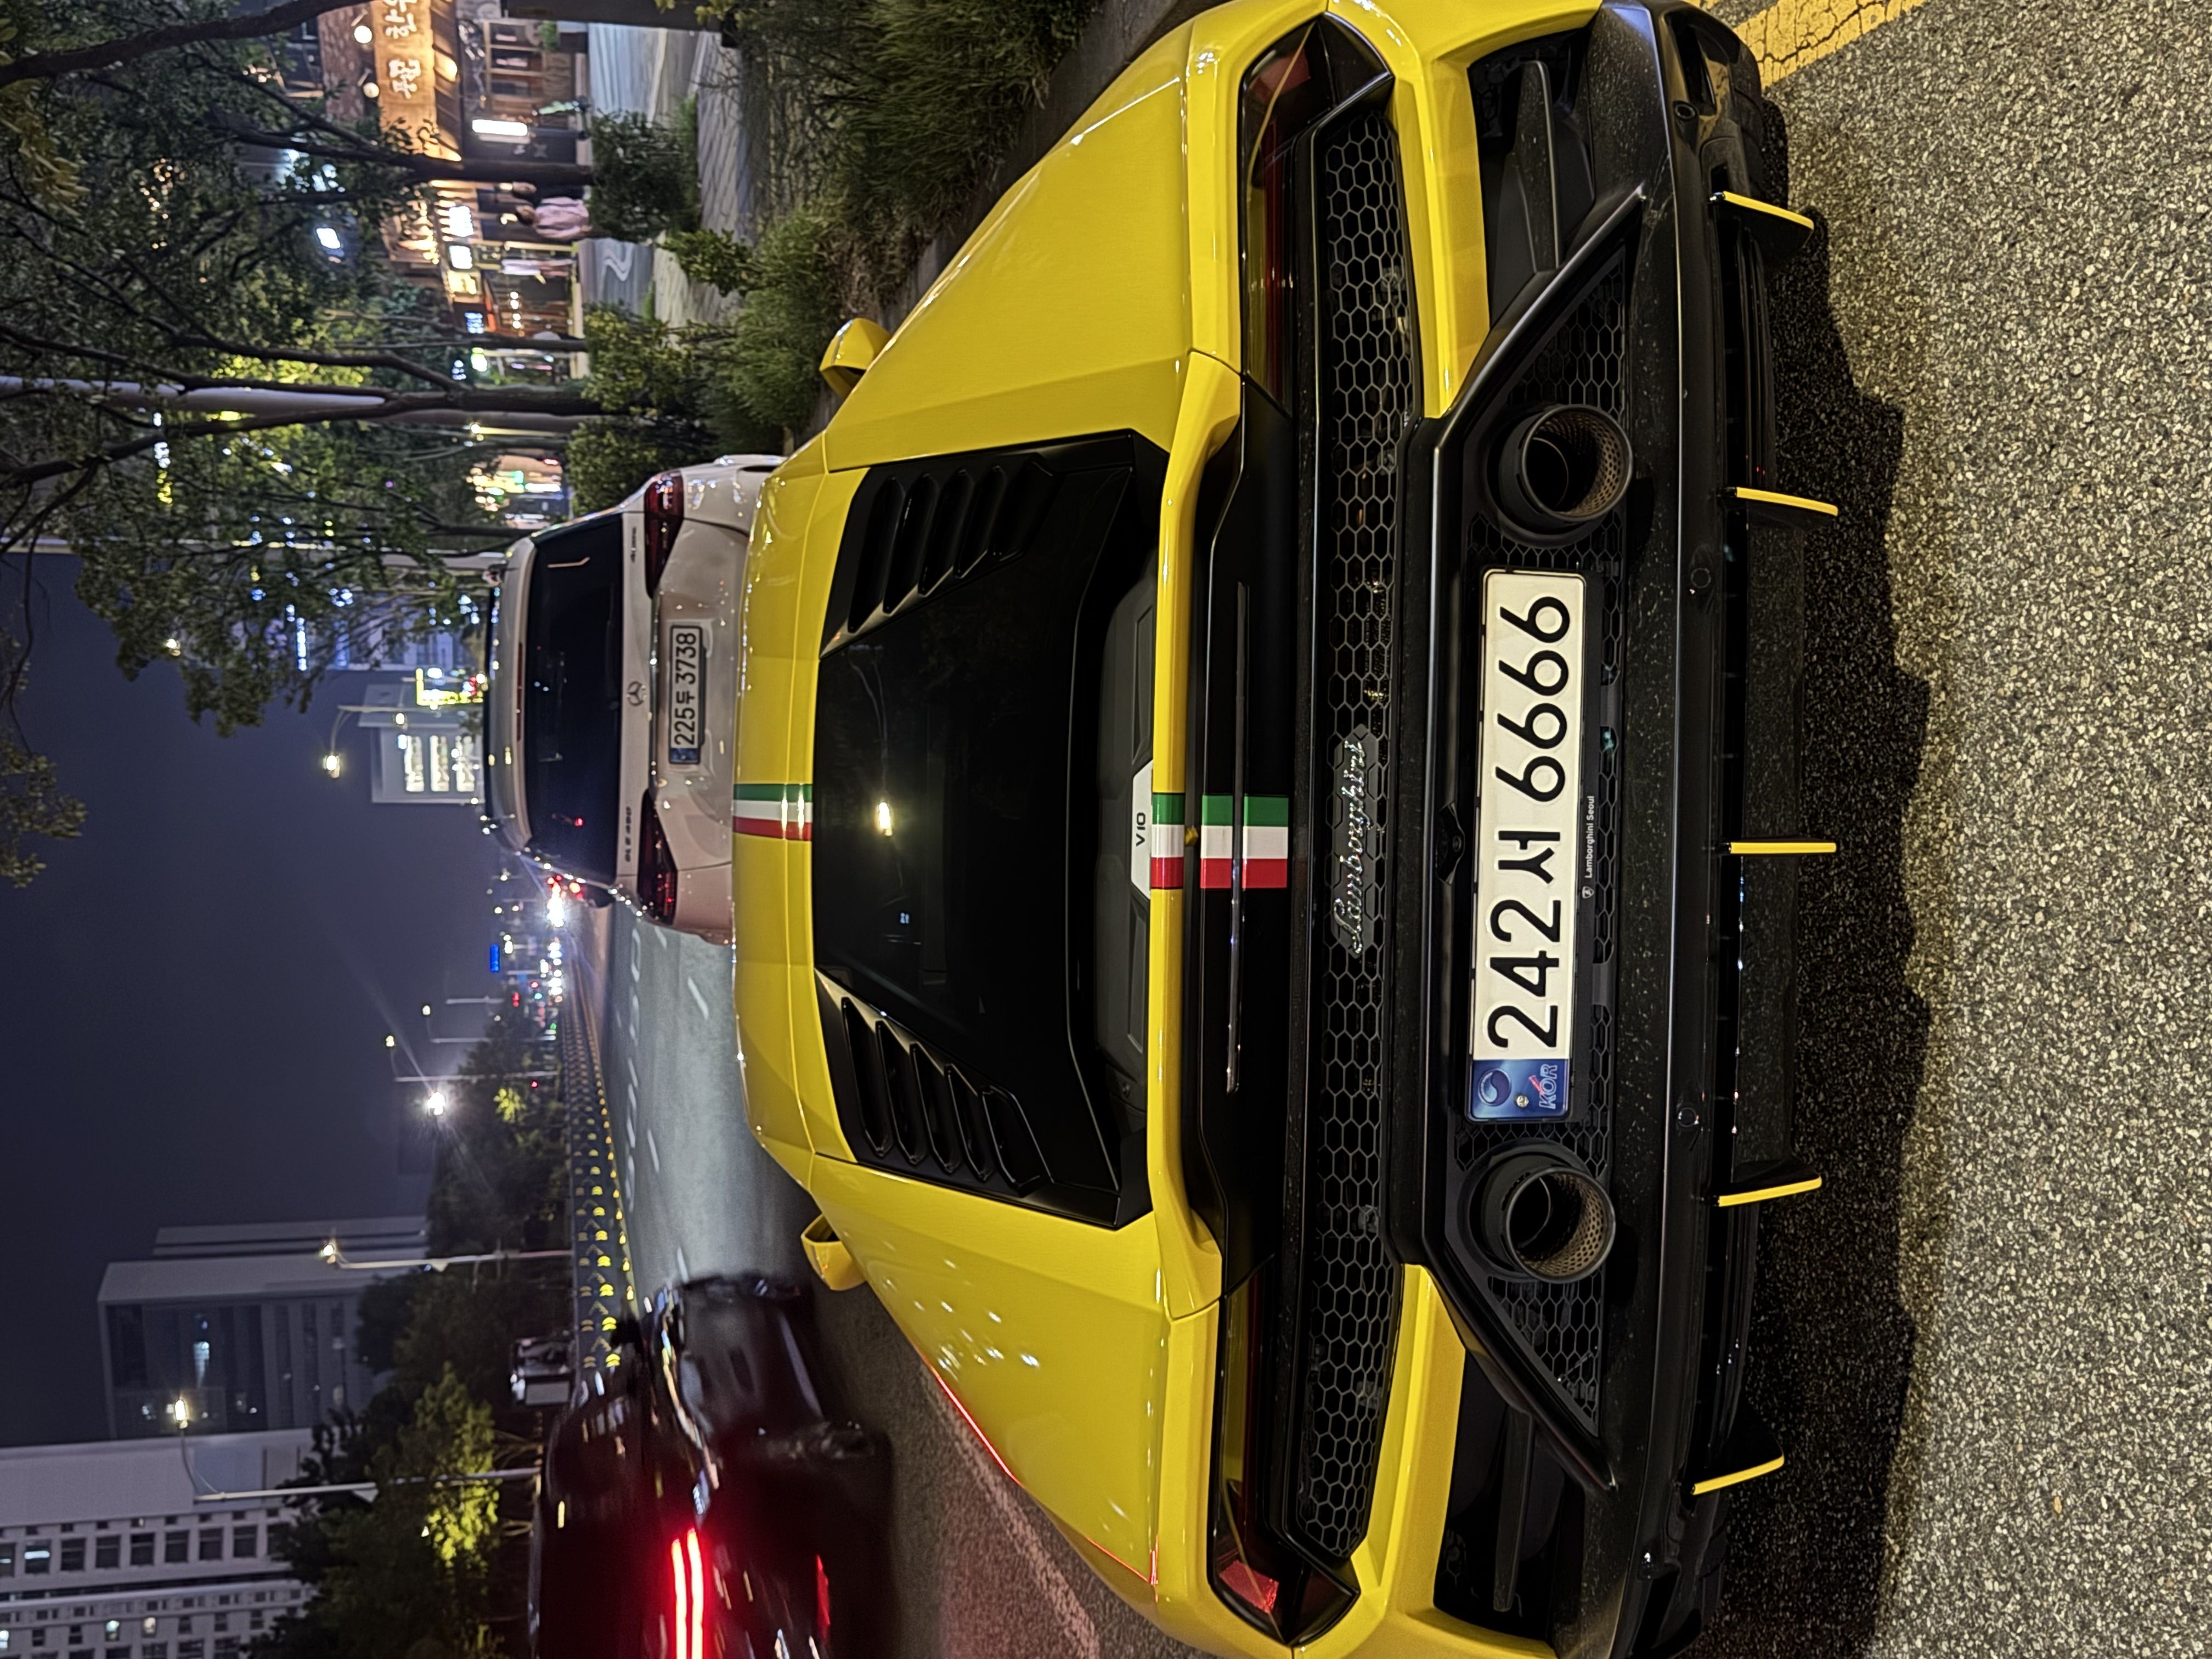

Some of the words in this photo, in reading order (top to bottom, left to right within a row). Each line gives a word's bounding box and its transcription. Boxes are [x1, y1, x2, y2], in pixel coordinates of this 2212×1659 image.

[675, 633, 696, 685] 3738
[674, 690, 696, 746] 225두
[1494, 595, 1571, 803] 6666
[1136, 812, 1146, 847] V10
[1586, 795, 1595, 821] Seoul
[1333, 740, 1373, 954] Lamborghini
[1584, 823, 1595, 878] Lamborghini
[1486, 830, 1562, 1049] 242서
[1538, 1064, 1558, 1109] KOR
